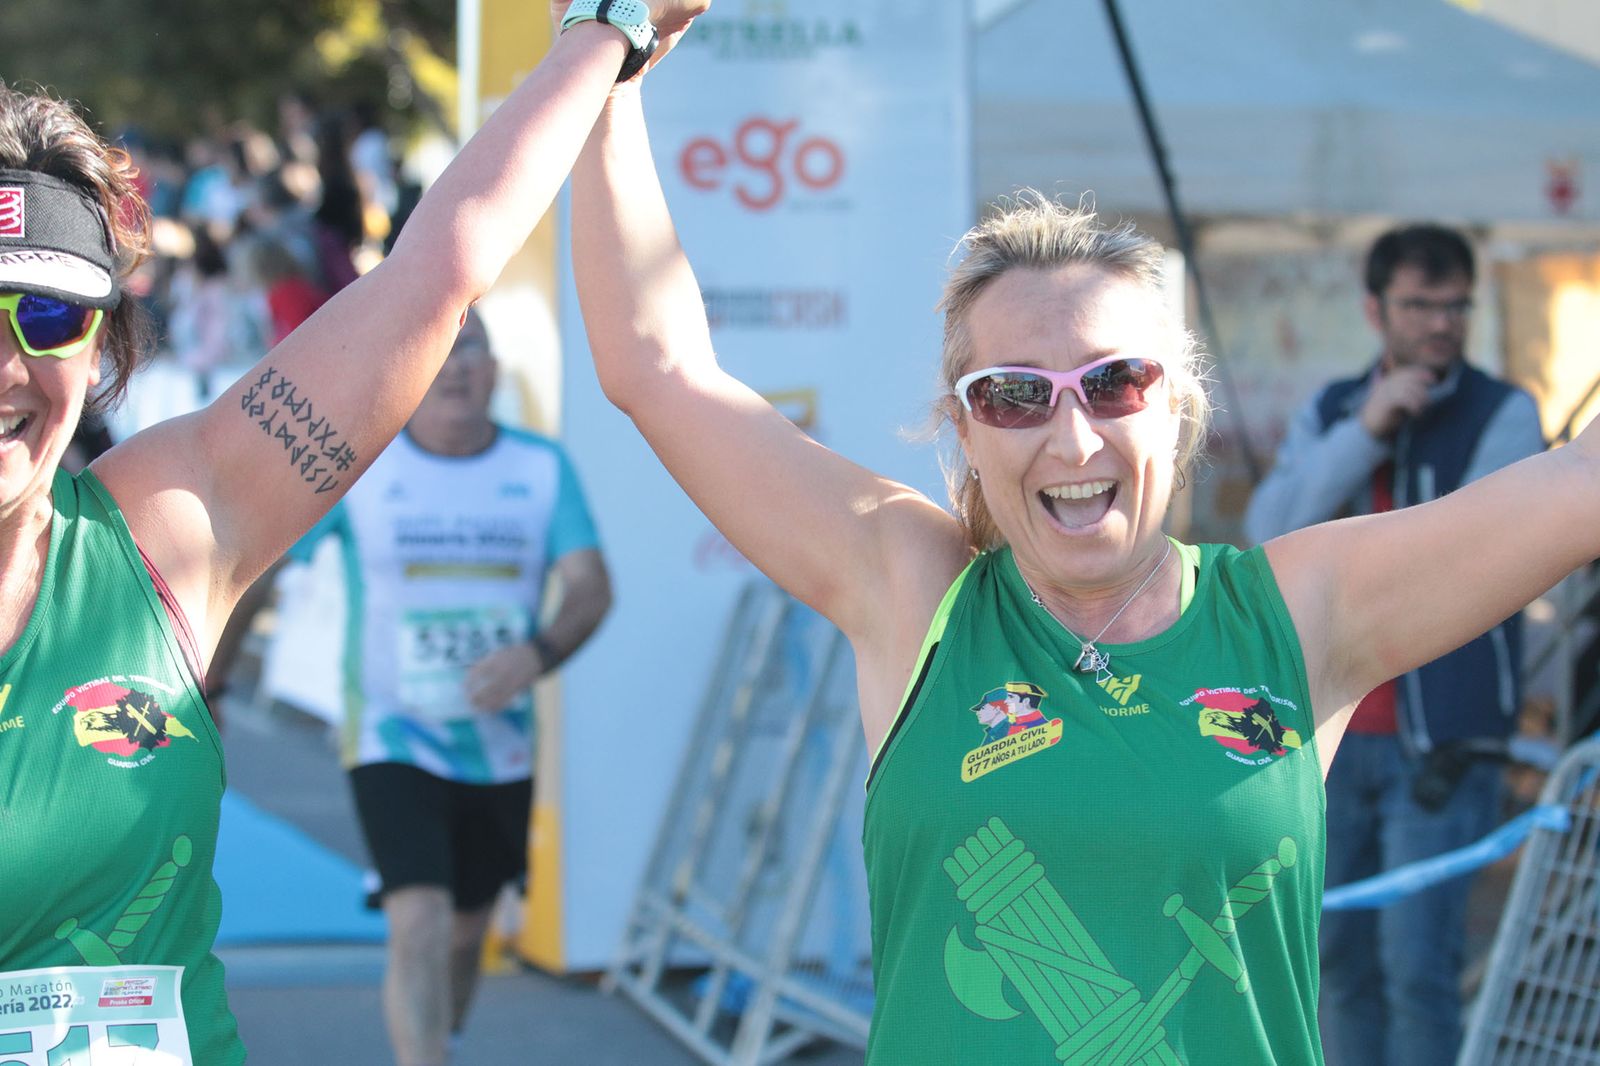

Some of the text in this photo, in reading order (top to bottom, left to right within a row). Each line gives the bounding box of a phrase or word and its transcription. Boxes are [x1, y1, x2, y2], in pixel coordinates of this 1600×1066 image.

[678, 115, 846, 212] ego
[1243, 687, 1258, 695] DEL
[967, 727, 1048, 764] GUARDIA CIVIL
[967, 736, 1046, 776] 177 AÑOS A TU LADO
[10, 980, 72, 996] Maratón
[0, 994, 73, 1015] ría 2022
